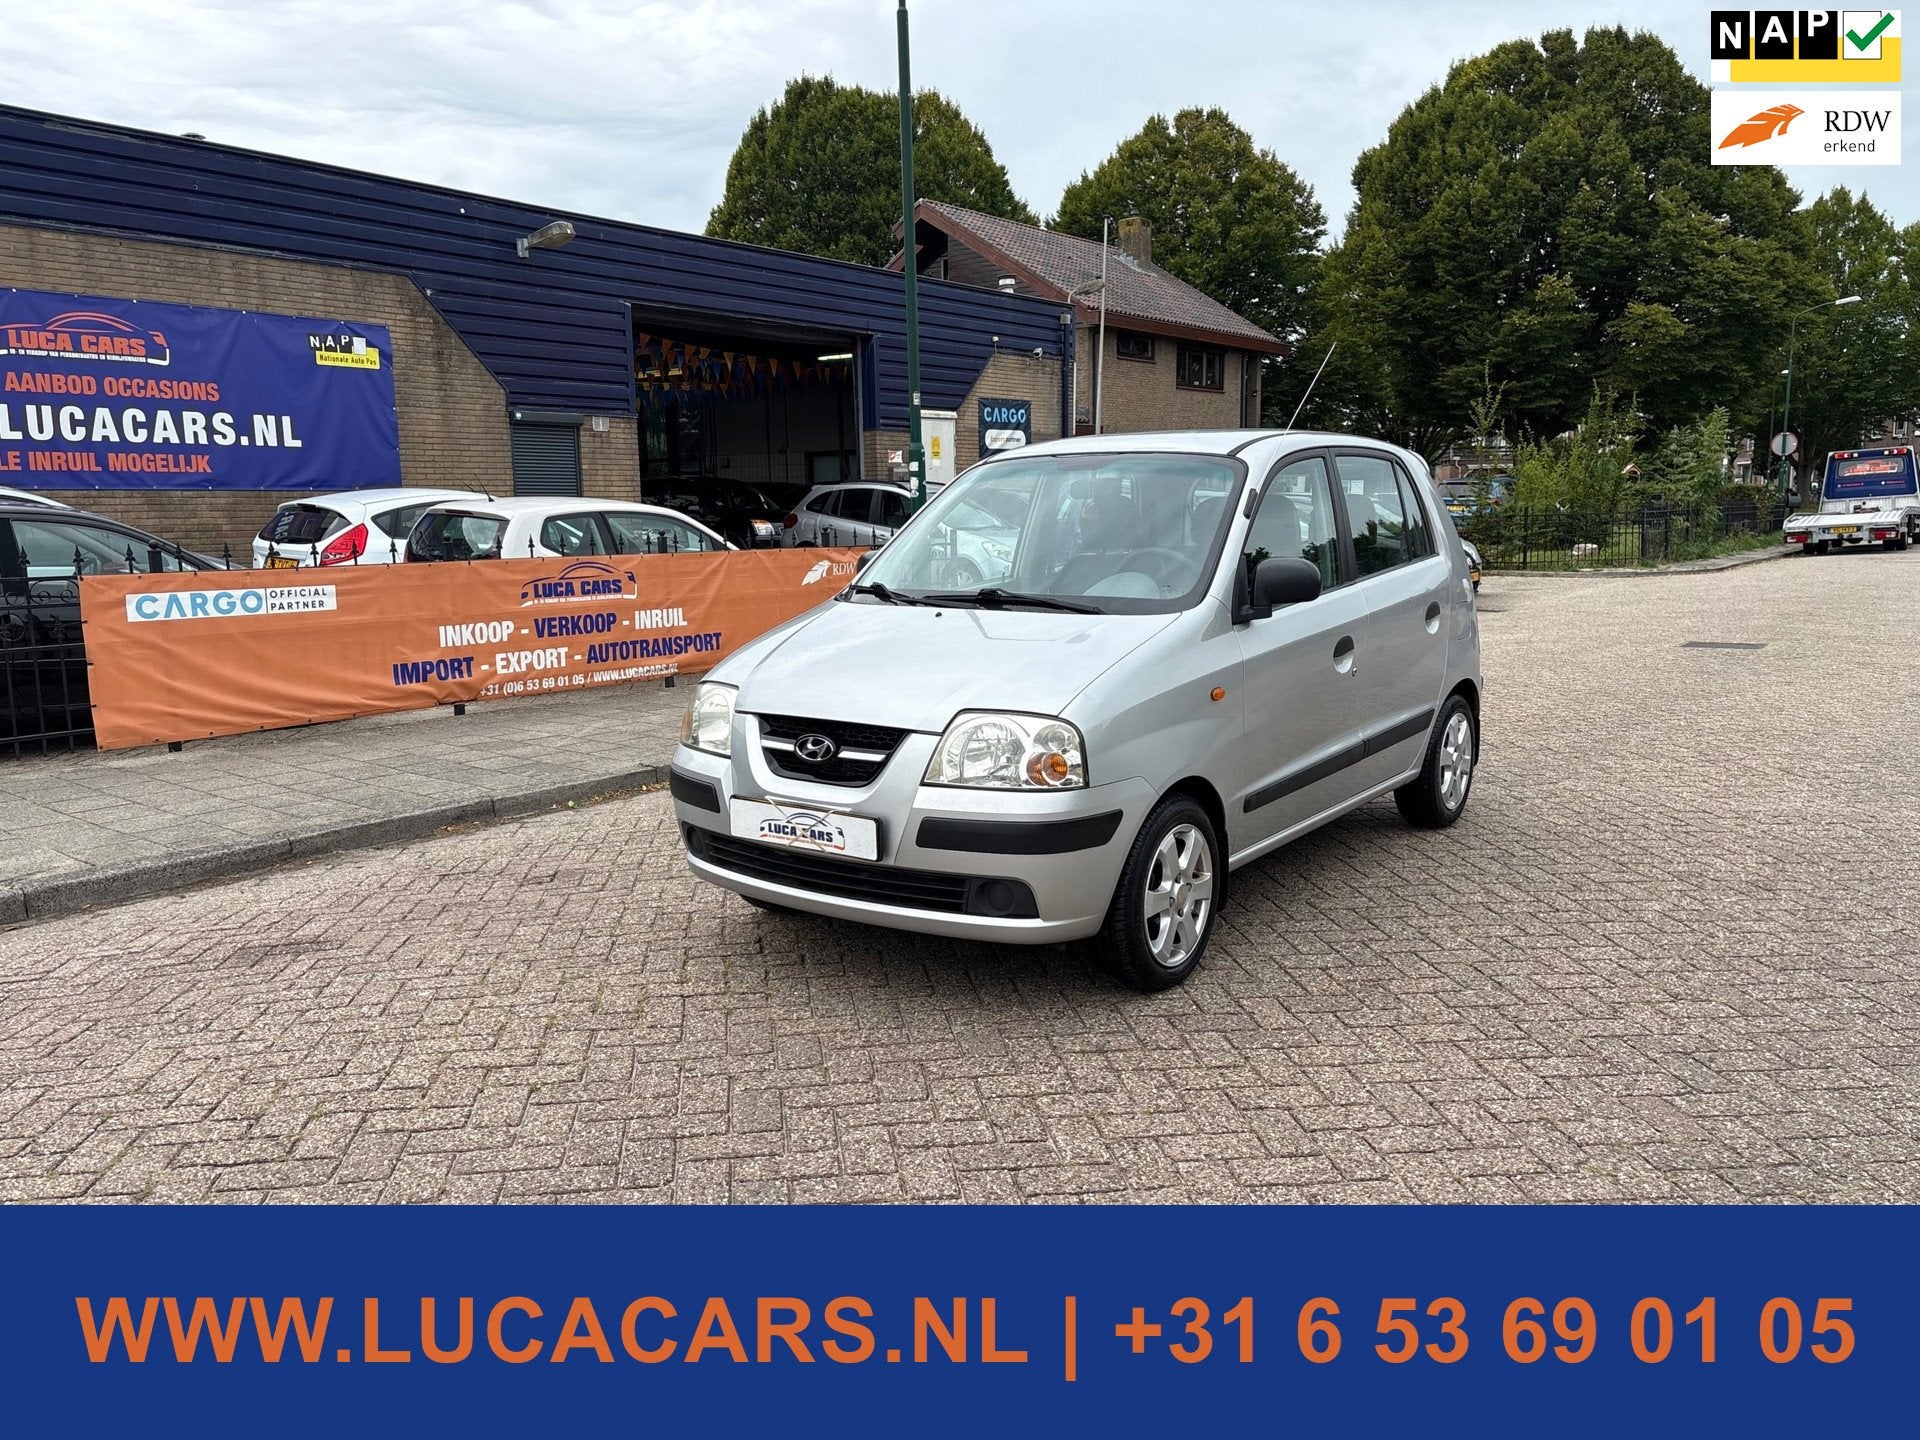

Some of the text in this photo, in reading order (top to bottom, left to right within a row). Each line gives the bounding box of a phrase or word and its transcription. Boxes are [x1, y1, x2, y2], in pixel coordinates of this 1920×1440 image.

[8, 330, 146, 356] LUCA CARS
[309, 335, 350, 348] NAP
[320, 354, 377, 366] Nationale Auto Pas
[5, 371, 219, 402] AANBOD OCCASIONS
[0, 403, 302, 448] LUCACARS.NL
[984, 407, 1026, 423] CARGO
[28, 451, 101, 472] INRUIL
[108, 453, 212, 474] MOGELIJK
[832, 562, 857, 576] RDW
[269, 588, 328, 599] OFFICIAL
[533, 579, 622, 598] LUCA CARS
[135, 590, 264, 619] CARGO
[270, 600, 325, 611] PARTNER
[439, 620, 514, 647] INKOOP
[534, 612, 617, 638] VERKOOP
[634, 608, 687, 630] INRUIL
[393, 656, 474, 686] IMPORT
[495, 647, 568, 675] EXPORT
[587, 632, 722, 665] AUTOTRANSPORT
[480, 683, 499, 697] +31
[503, 680, 524, 696] (0)6
[526, 678, 540, 690] 53
[542, 677, 555, 689] 69
[557, 675, 569, 687] 01
[572, 674, 585, 685] 05
[593, 662, 679, 683] WWW.LUCACARS.NL
[768, 822, 797, 836] LUCA
